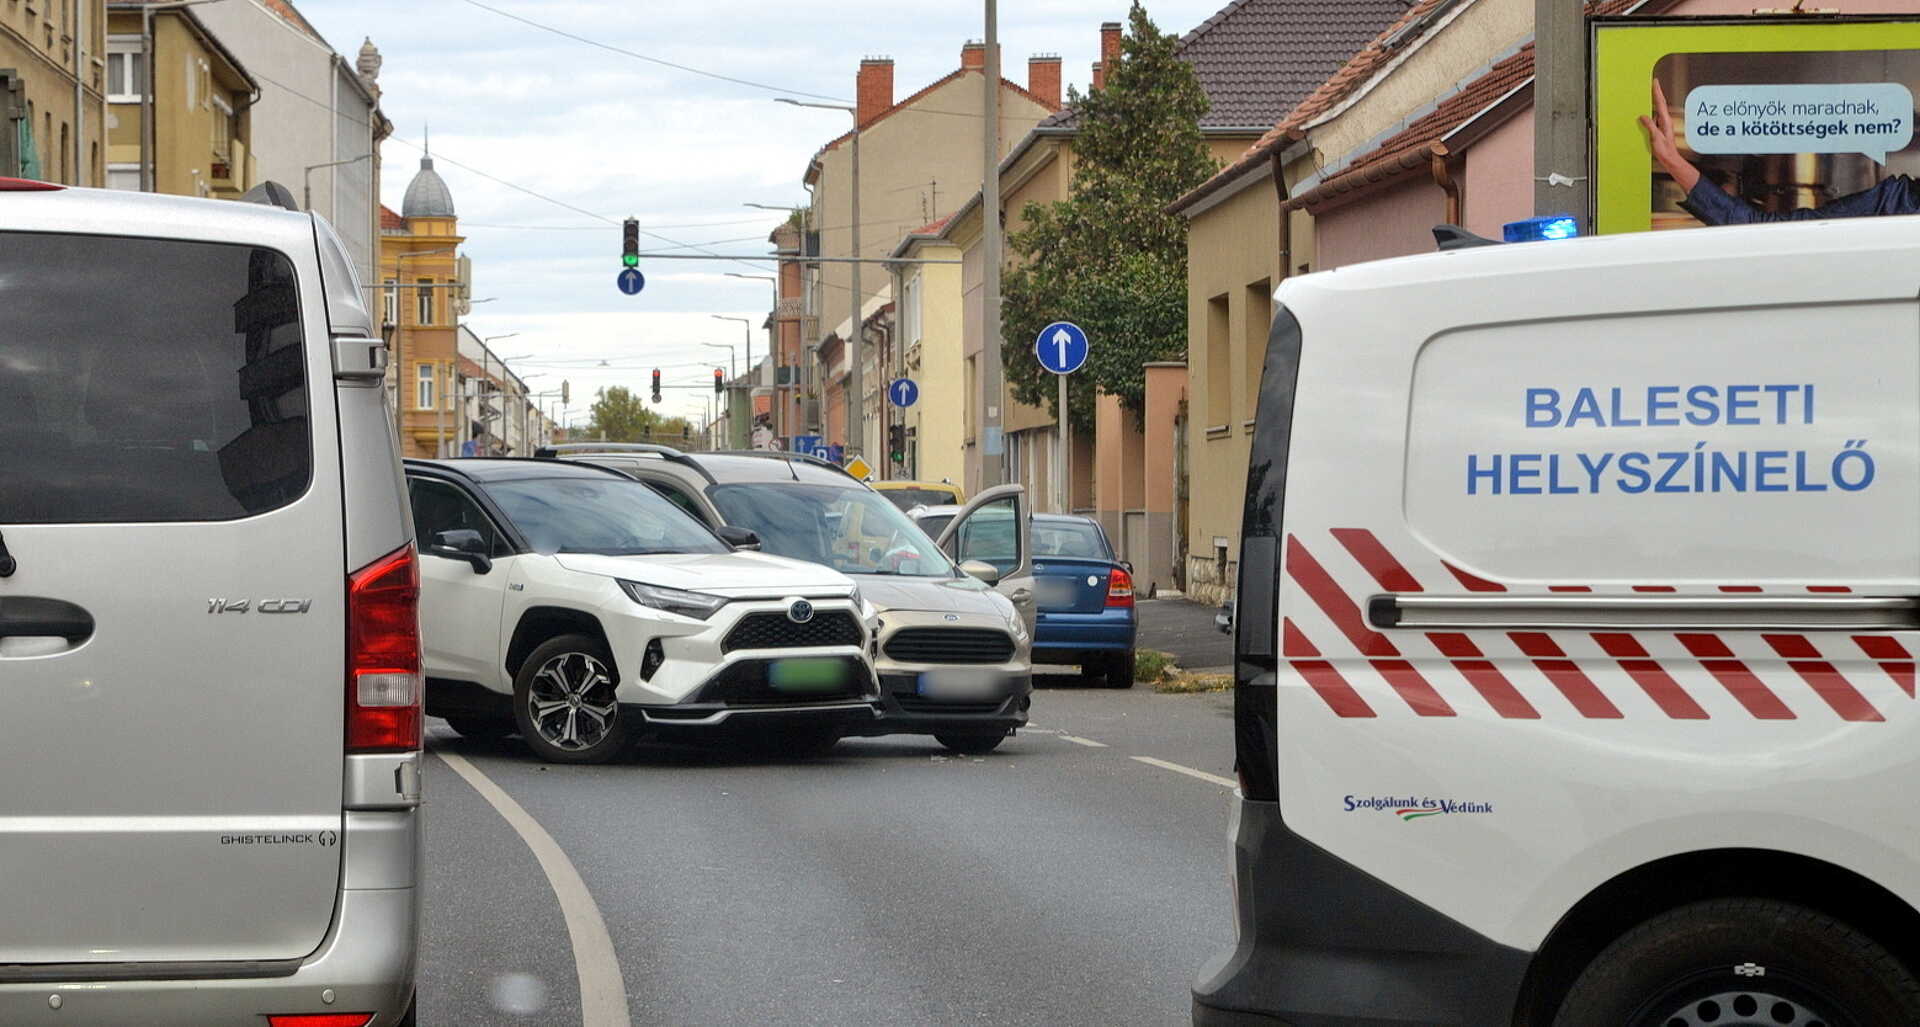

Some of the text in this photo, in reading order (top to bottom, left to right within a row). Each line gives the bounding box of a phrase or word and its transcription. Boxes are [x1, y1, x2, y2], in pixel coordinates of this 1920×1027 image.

[1696, 99, 1880, 120] Az előnyök maradnak,
[1696, 118, 1902, 139] de a kötöttségek nem?
[1525, 384, 1814, 428] BALESETI
[1466, 439, 1876, 496] HELYSZÍNELŐ
[207, 598, 312, 614] 114 CDI
[1343, 795, 1493, 814] Szolgálunk és Védünk
[221, 834, 314, 845] GHISTELINCK
